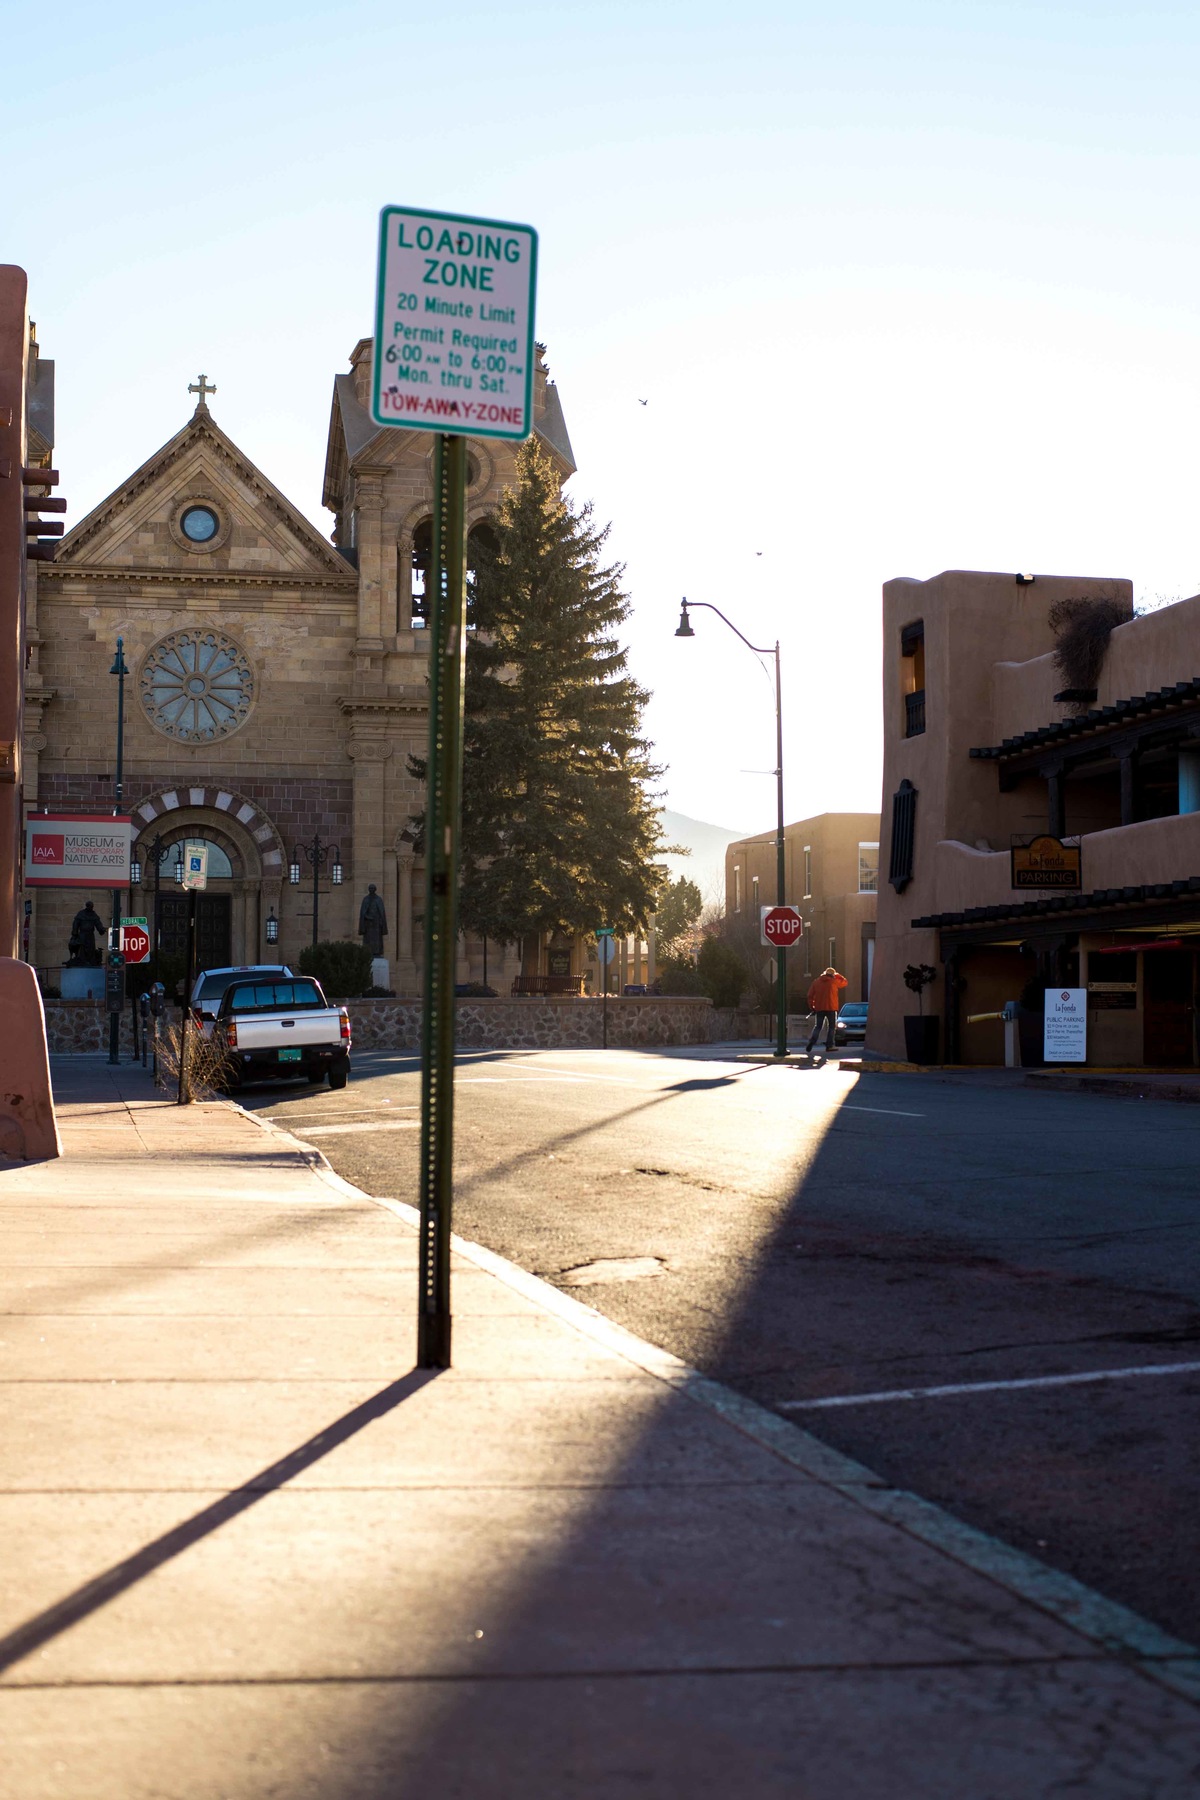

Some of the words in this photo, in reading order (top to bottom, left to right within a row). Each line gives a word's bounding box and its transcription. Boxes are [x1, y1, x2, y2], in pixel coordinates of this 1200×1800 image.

[398, 223, 520, 263] LOADING
[422, 258, 494, 292] ZONE
[397, 293, 418, 311] 20
[425, 296, 473, 318] Minute
[480, 303, 515, 324] Limit
[394, 322, 444, 344] Permit
[452, 329, 517, 353] Required
[385, 344, 422, 363] 6:00
[449, 352, 462, 367] to
[471, 354, 506, 373] 6:00
[398, 365, 432, 384] Mon.
[441, 371, 472, 389] thru
[480, 374, 509, 394] Sat.
[382, 392, 522, 425] TOW-AWAY-ZONE
[65, 837, 113, 847] MUSEUM
[34, 847, 55, 857] IAIA
[65, 847, 124, 855] CONTEMPORARY
[65, 854, 98, 863] NATIVE
[101, 855, 125, 864] ARTS
[1029, 853, 1038, 866] La
[1040, 853, 1064, 868] Fonda
[1020, 872, 1073, 883] PARKING
[767, 919, 799, 934] STOP
[124, 938, 146, 951] TOP
[1055, 1003, 1060, 1011] La
[1062, 1003, 1076, 1013] Fonda
